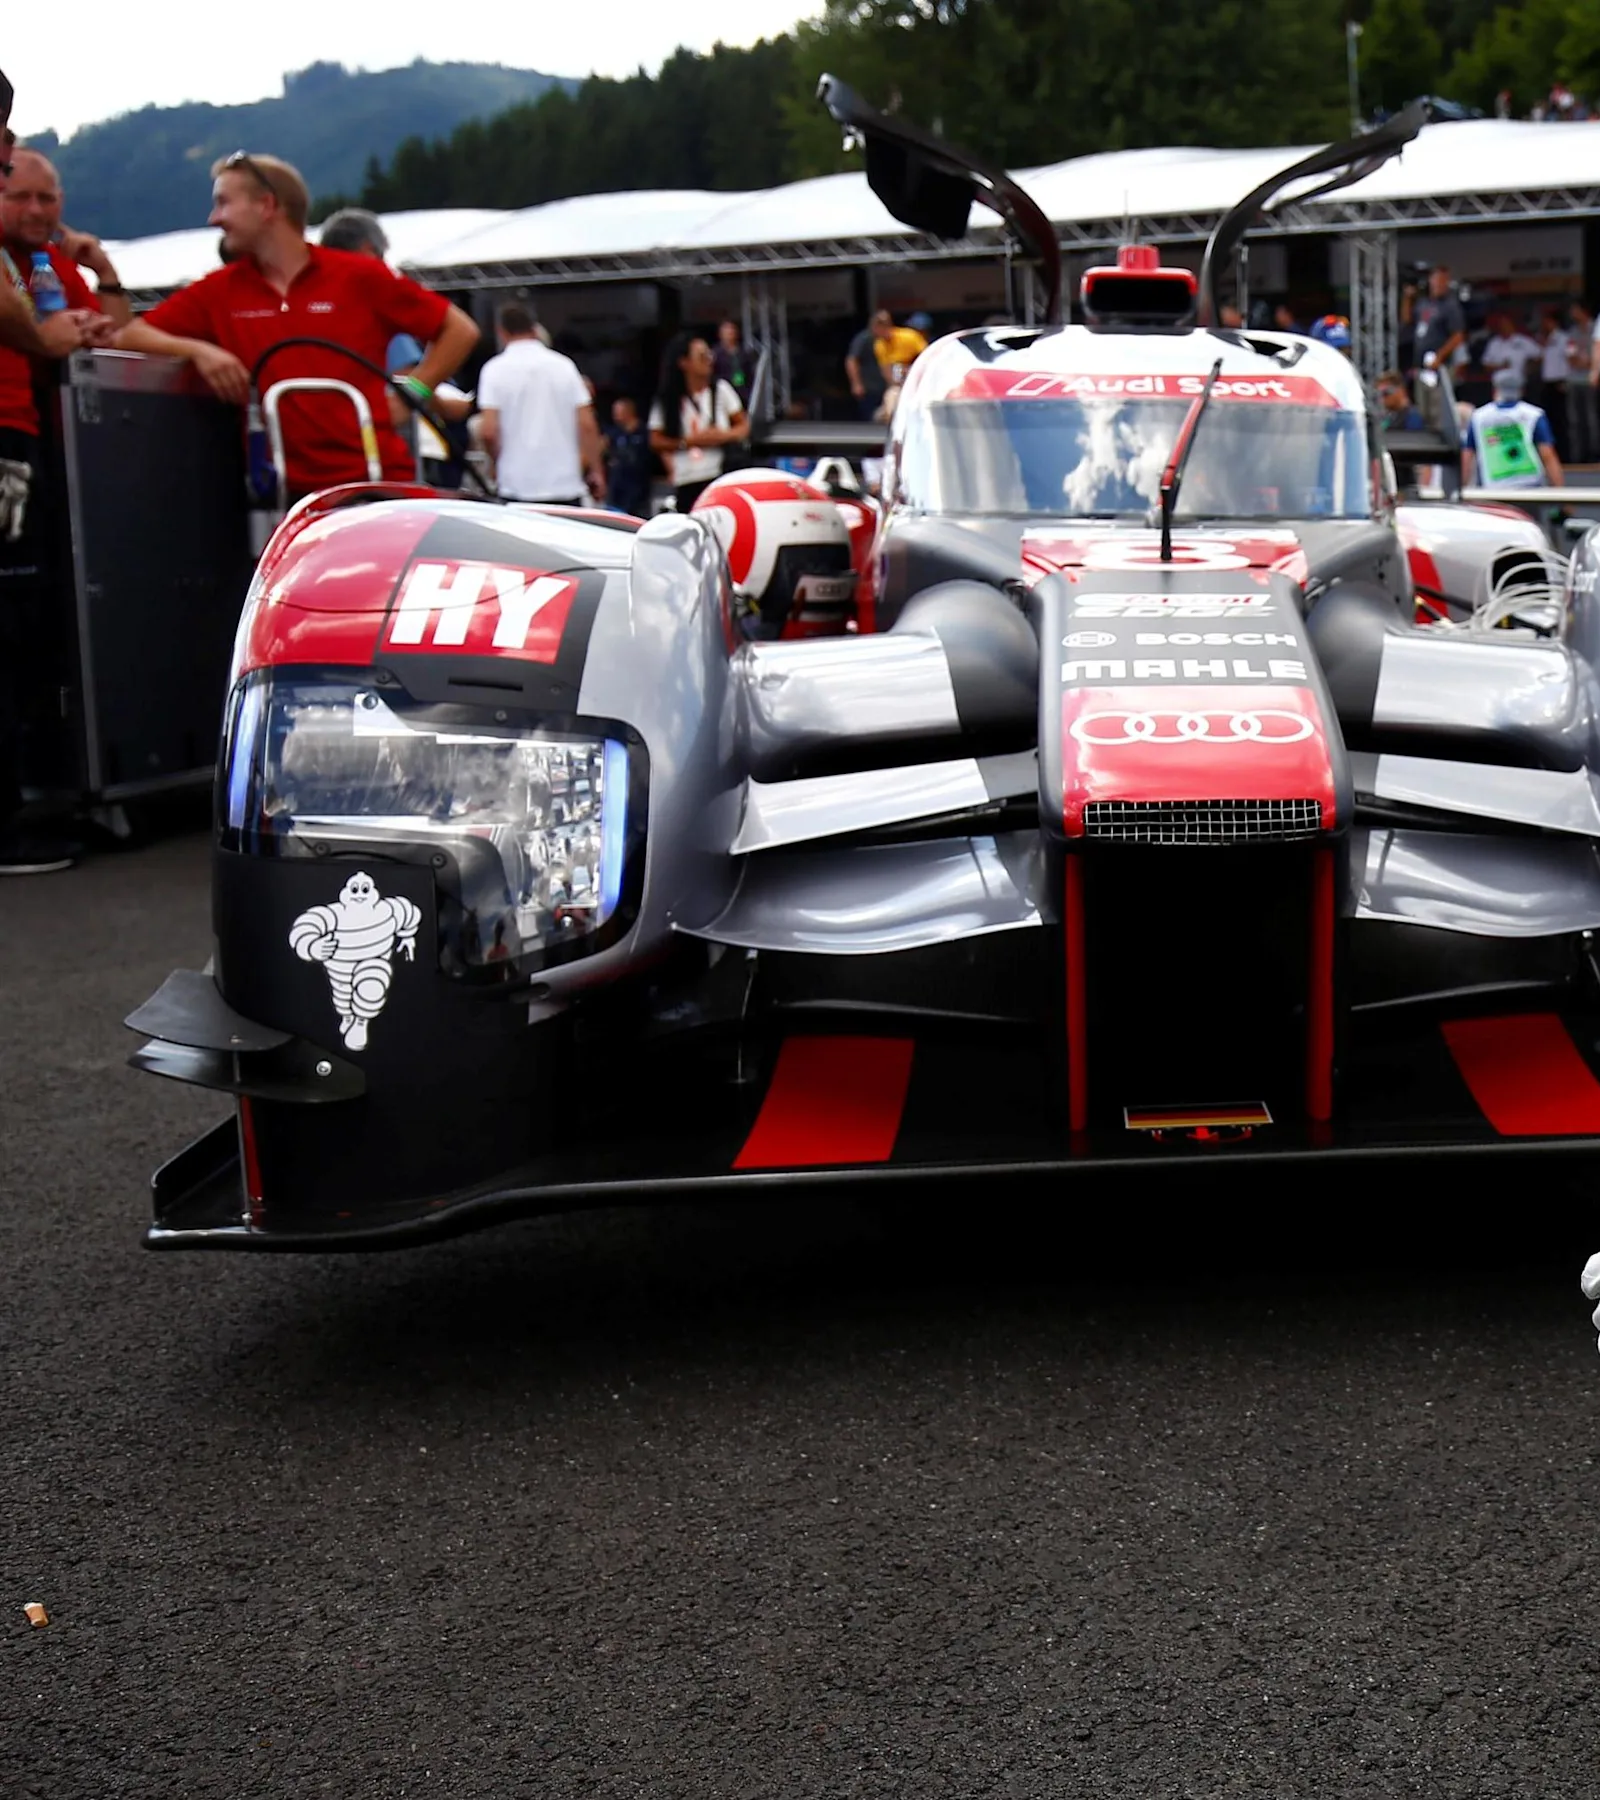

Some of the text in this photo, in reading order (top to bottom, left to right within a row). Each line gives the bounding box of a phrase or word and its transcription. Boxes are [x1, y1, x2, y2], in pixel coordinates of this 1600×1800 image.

[1062, 376, 1292, 399] Audi Sport
[389, 563, 570, 650] HY
[1135, 632, 1298, 647] BOSCH
[1061, 659, 1308, 682] MAHLE
